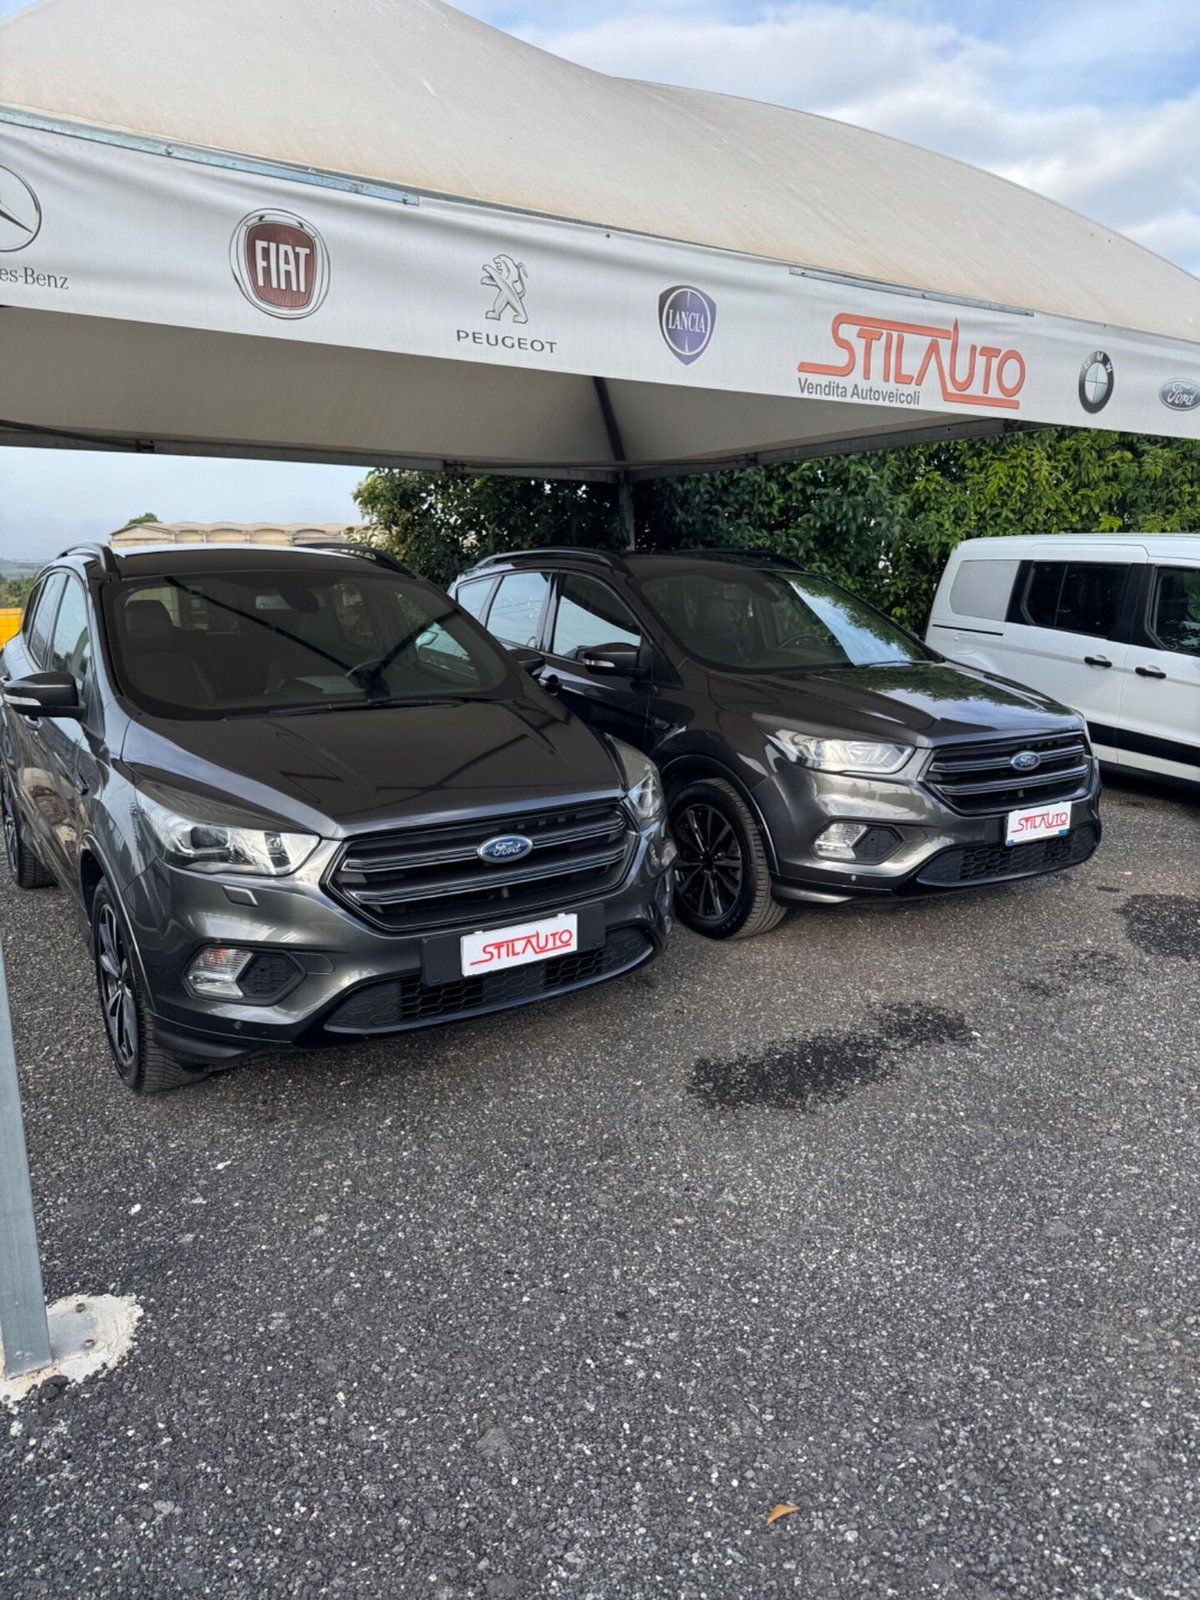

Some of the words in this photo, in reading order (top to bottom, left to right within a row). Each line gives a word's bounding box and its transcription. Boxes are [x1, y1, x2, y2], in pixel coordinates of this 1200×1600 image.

[255, 239, 310, 293] FIAT
[668, 308, 706, 334] LANCIA
[456, 329, 558, 354] PEUGEOT
[797, 312, 1026, 410] STILAUTO
[797, 376, 848, 399] Vendita
[849, 384, 921, 406] Autoveicoli
[1166, 383, 1197, 406] Ford
[1010, 811, 1069, 834] STILAUTO
[493, 841, 521, 857] Ford
[469, 929, 573, 967] STILAUTO
